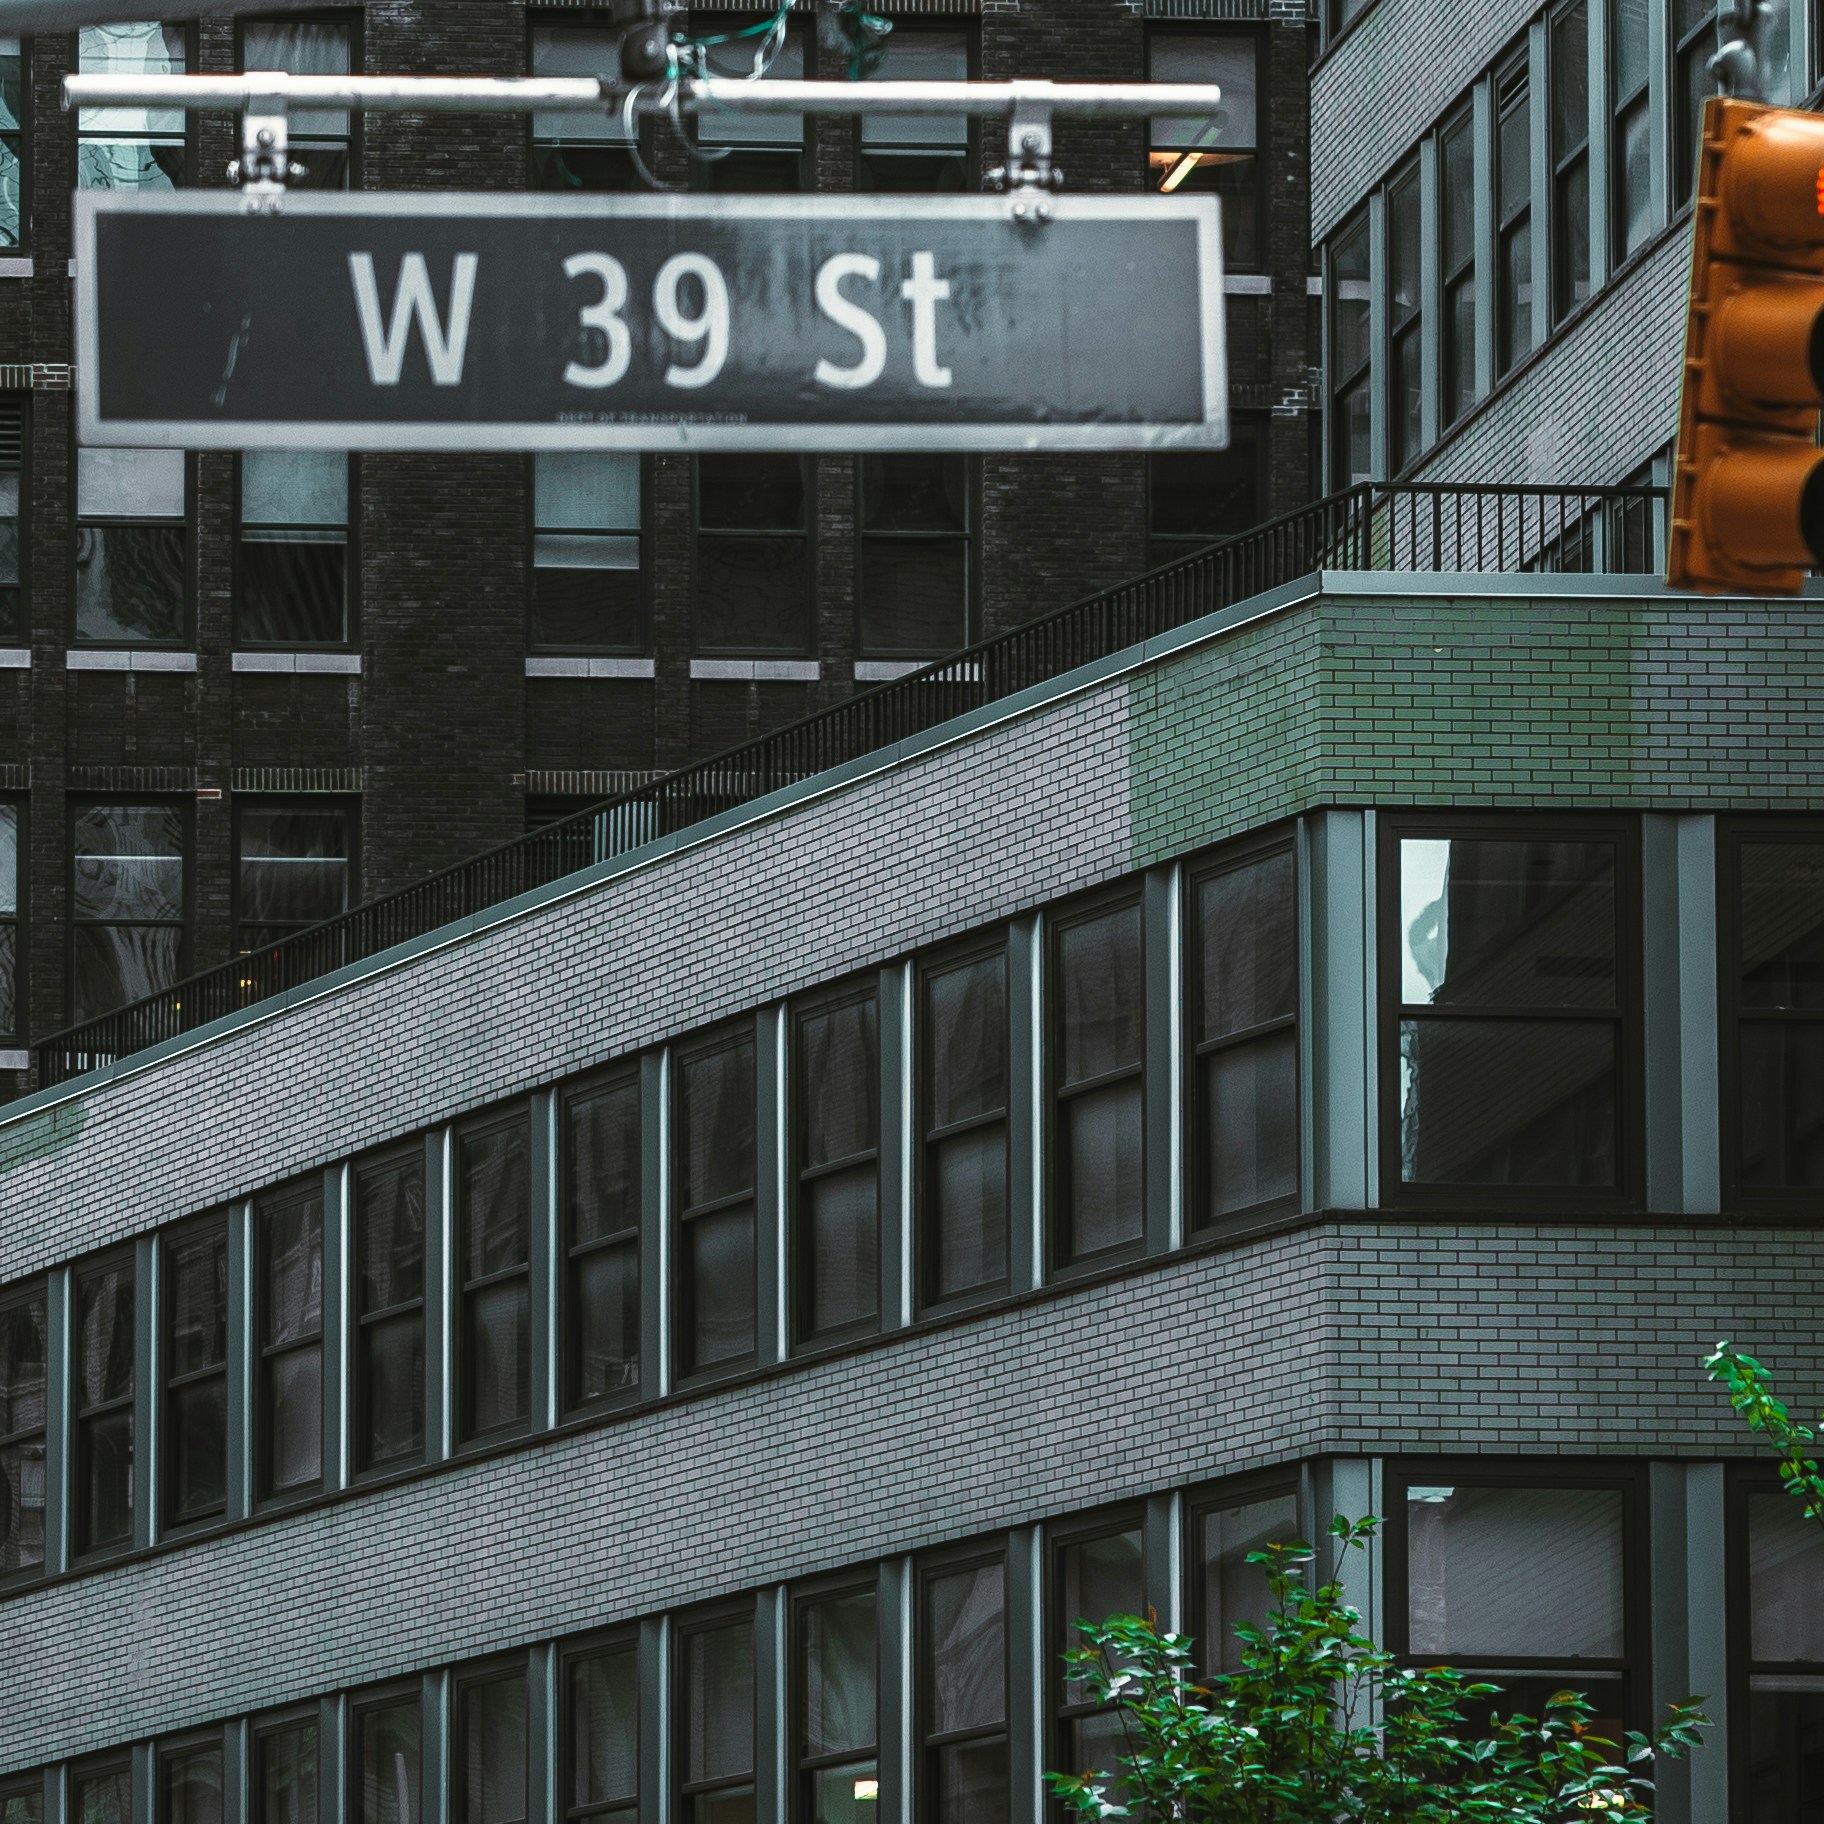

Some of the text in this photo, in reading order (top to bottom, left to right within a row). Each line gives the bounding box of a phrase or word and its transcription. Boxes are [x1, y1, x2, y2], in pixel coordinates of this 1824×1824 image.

[349, 248, 955, 390] W 39 St
